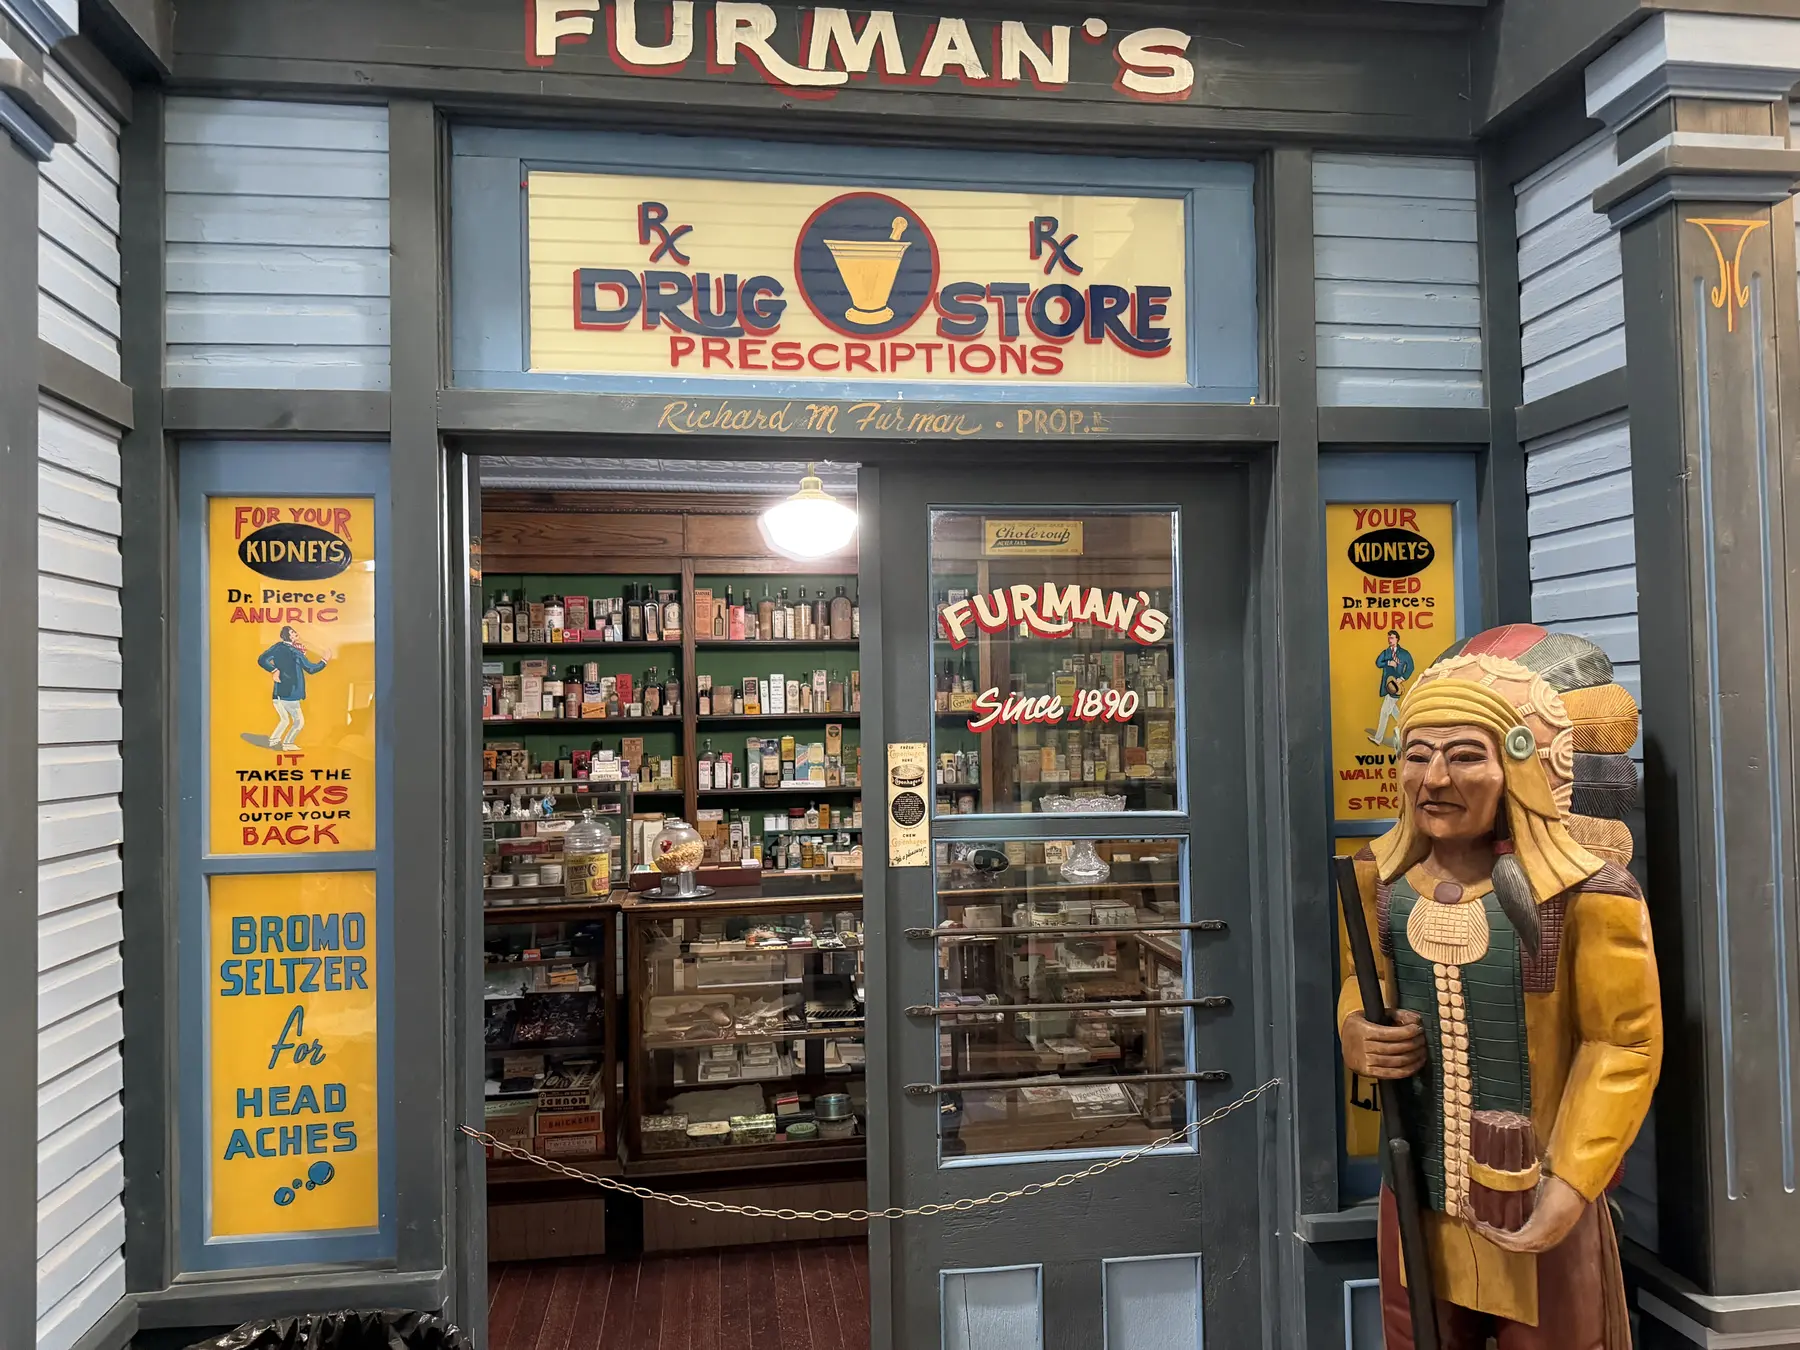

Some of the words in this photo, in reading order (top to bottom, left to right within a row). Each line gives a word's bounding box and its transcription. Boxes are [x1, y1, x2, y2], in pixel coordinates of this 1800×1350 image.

[525, 0, 1194, 100] FURMAN'S
[573, 266, 787, 337] DRUG
[936, 281, 1172, 357] STORE
[670, 337, 1064, 374] PRESCRIPTIONS
[657, 399, 793, 433] Richard
[805, 403, 838, 434] M
[847, 402, 982, 435] Furman
[235, 506, 281, 540] FOR
[289, 507, 352, 541] YOUR
[1353, 508, 1420, 531] YOUR
[995, 526, 1071, 544] Choleroup
[245, 540, 346, 564] KIDNEYS
[1353, 541, 1430, 563] KIDNEYS
[227, 588, 253, 604] Dr.
[262, 588, 346, 604] Pierce's
[1362, 576, 1421, 594] NEED
[1342, 596, 1363, 608] Dr.
[1366, 596, 1435, 608] Pierce's
[230, 606, 340, 624] ANURIC
[939, 582, 1169, 650] FURMAN'S
[1339, 611, 1434, 631] ANURIC
[967, 686, 1065, 733] Since
[1066, 688, 1139, 723] 1890
[276, 754, 305, 766] IT
[1355, 754, 1385, 766] YOU
[236, 769, 305, 782] TAKES
[314, 768, 352, 781] THE
[1339, 768, 1384, 780] WALK
[241, 785, 349, 808] KINKS
[1380, 782, 1398, 793] AN
[298, 809, 351, 820] YOUR
[242, 824, 340, 846] BACK
[231, 911, 366, 955] BROMO
[220, 955, 368, 996] SELTZER
[236, 1082, 347, 1119] HEAD
[223, 1121, 357, 1160] ACHES
